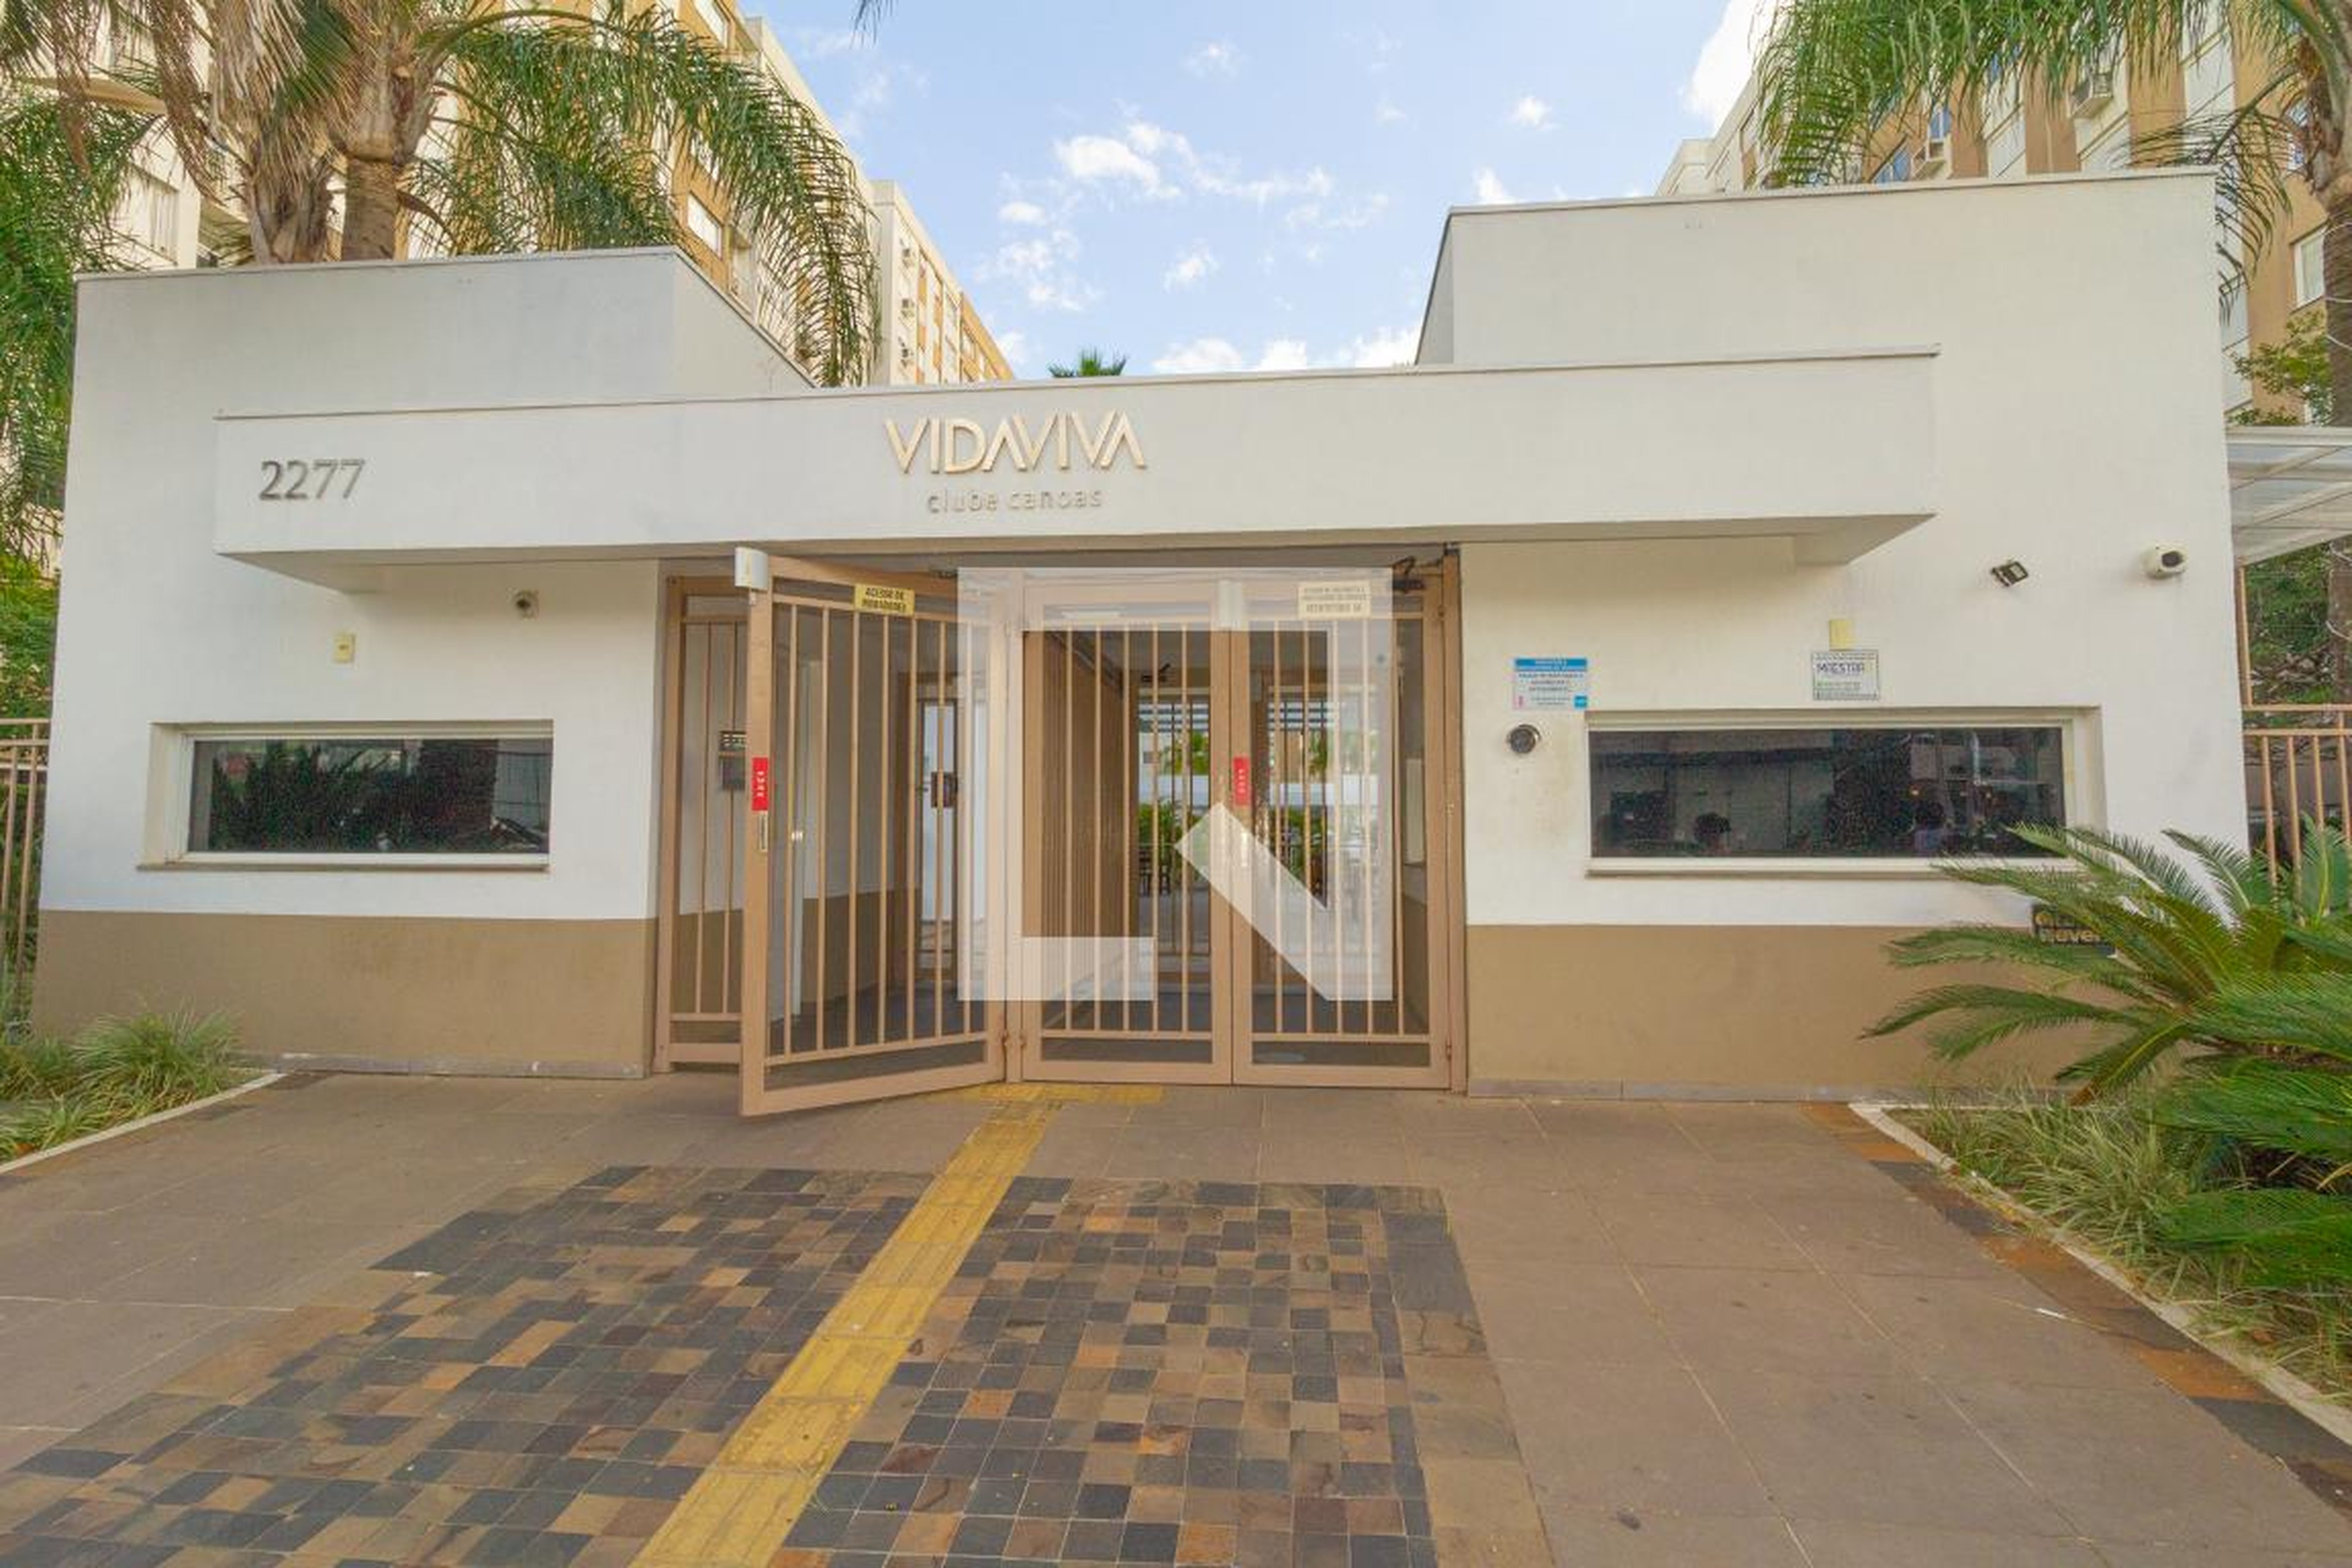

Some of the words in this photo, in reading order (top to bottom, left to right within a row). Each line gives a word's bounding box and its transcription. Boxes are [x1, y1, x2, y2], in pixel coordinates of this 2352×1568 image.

[259, 458, 366, 500] 2277
[928, 488, 997, 513] clube
[1009, 489, 1102, 510] canoas
